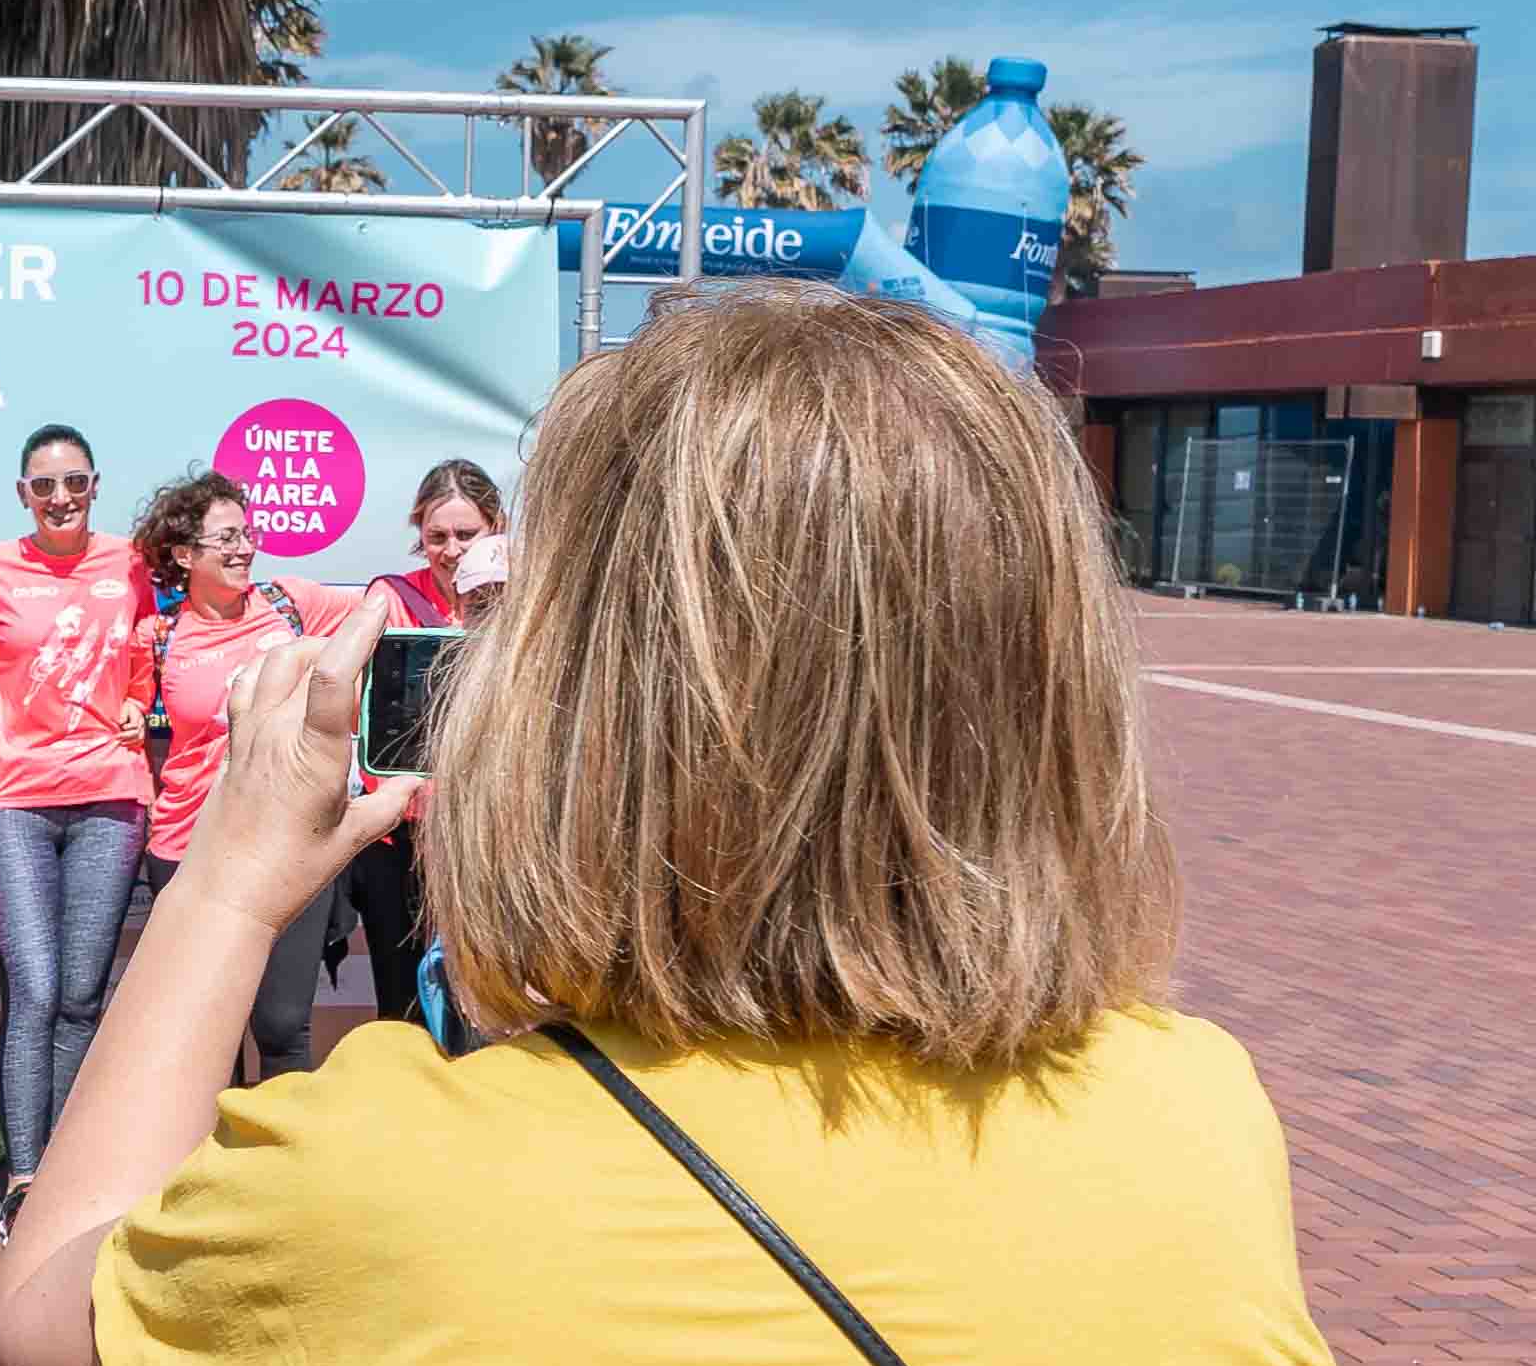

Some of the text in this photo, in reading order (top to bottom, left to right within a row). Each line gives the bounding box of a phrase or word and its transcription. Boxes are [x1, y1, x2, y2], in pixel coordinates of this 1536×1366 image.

[603, 206, 803, 262] Foneide
[1010, 231, 1058, 266] Fon
[138, 270, 445, 319] 10 DE MARZO
[231, 320, 349, 359] 2024
[244, 424, 334, 453] ÚNETE
[258, 457, 320, 479] A LA
[241, 484, 337, 507] MAREA
[253, 510, 325, 533] ROSA
